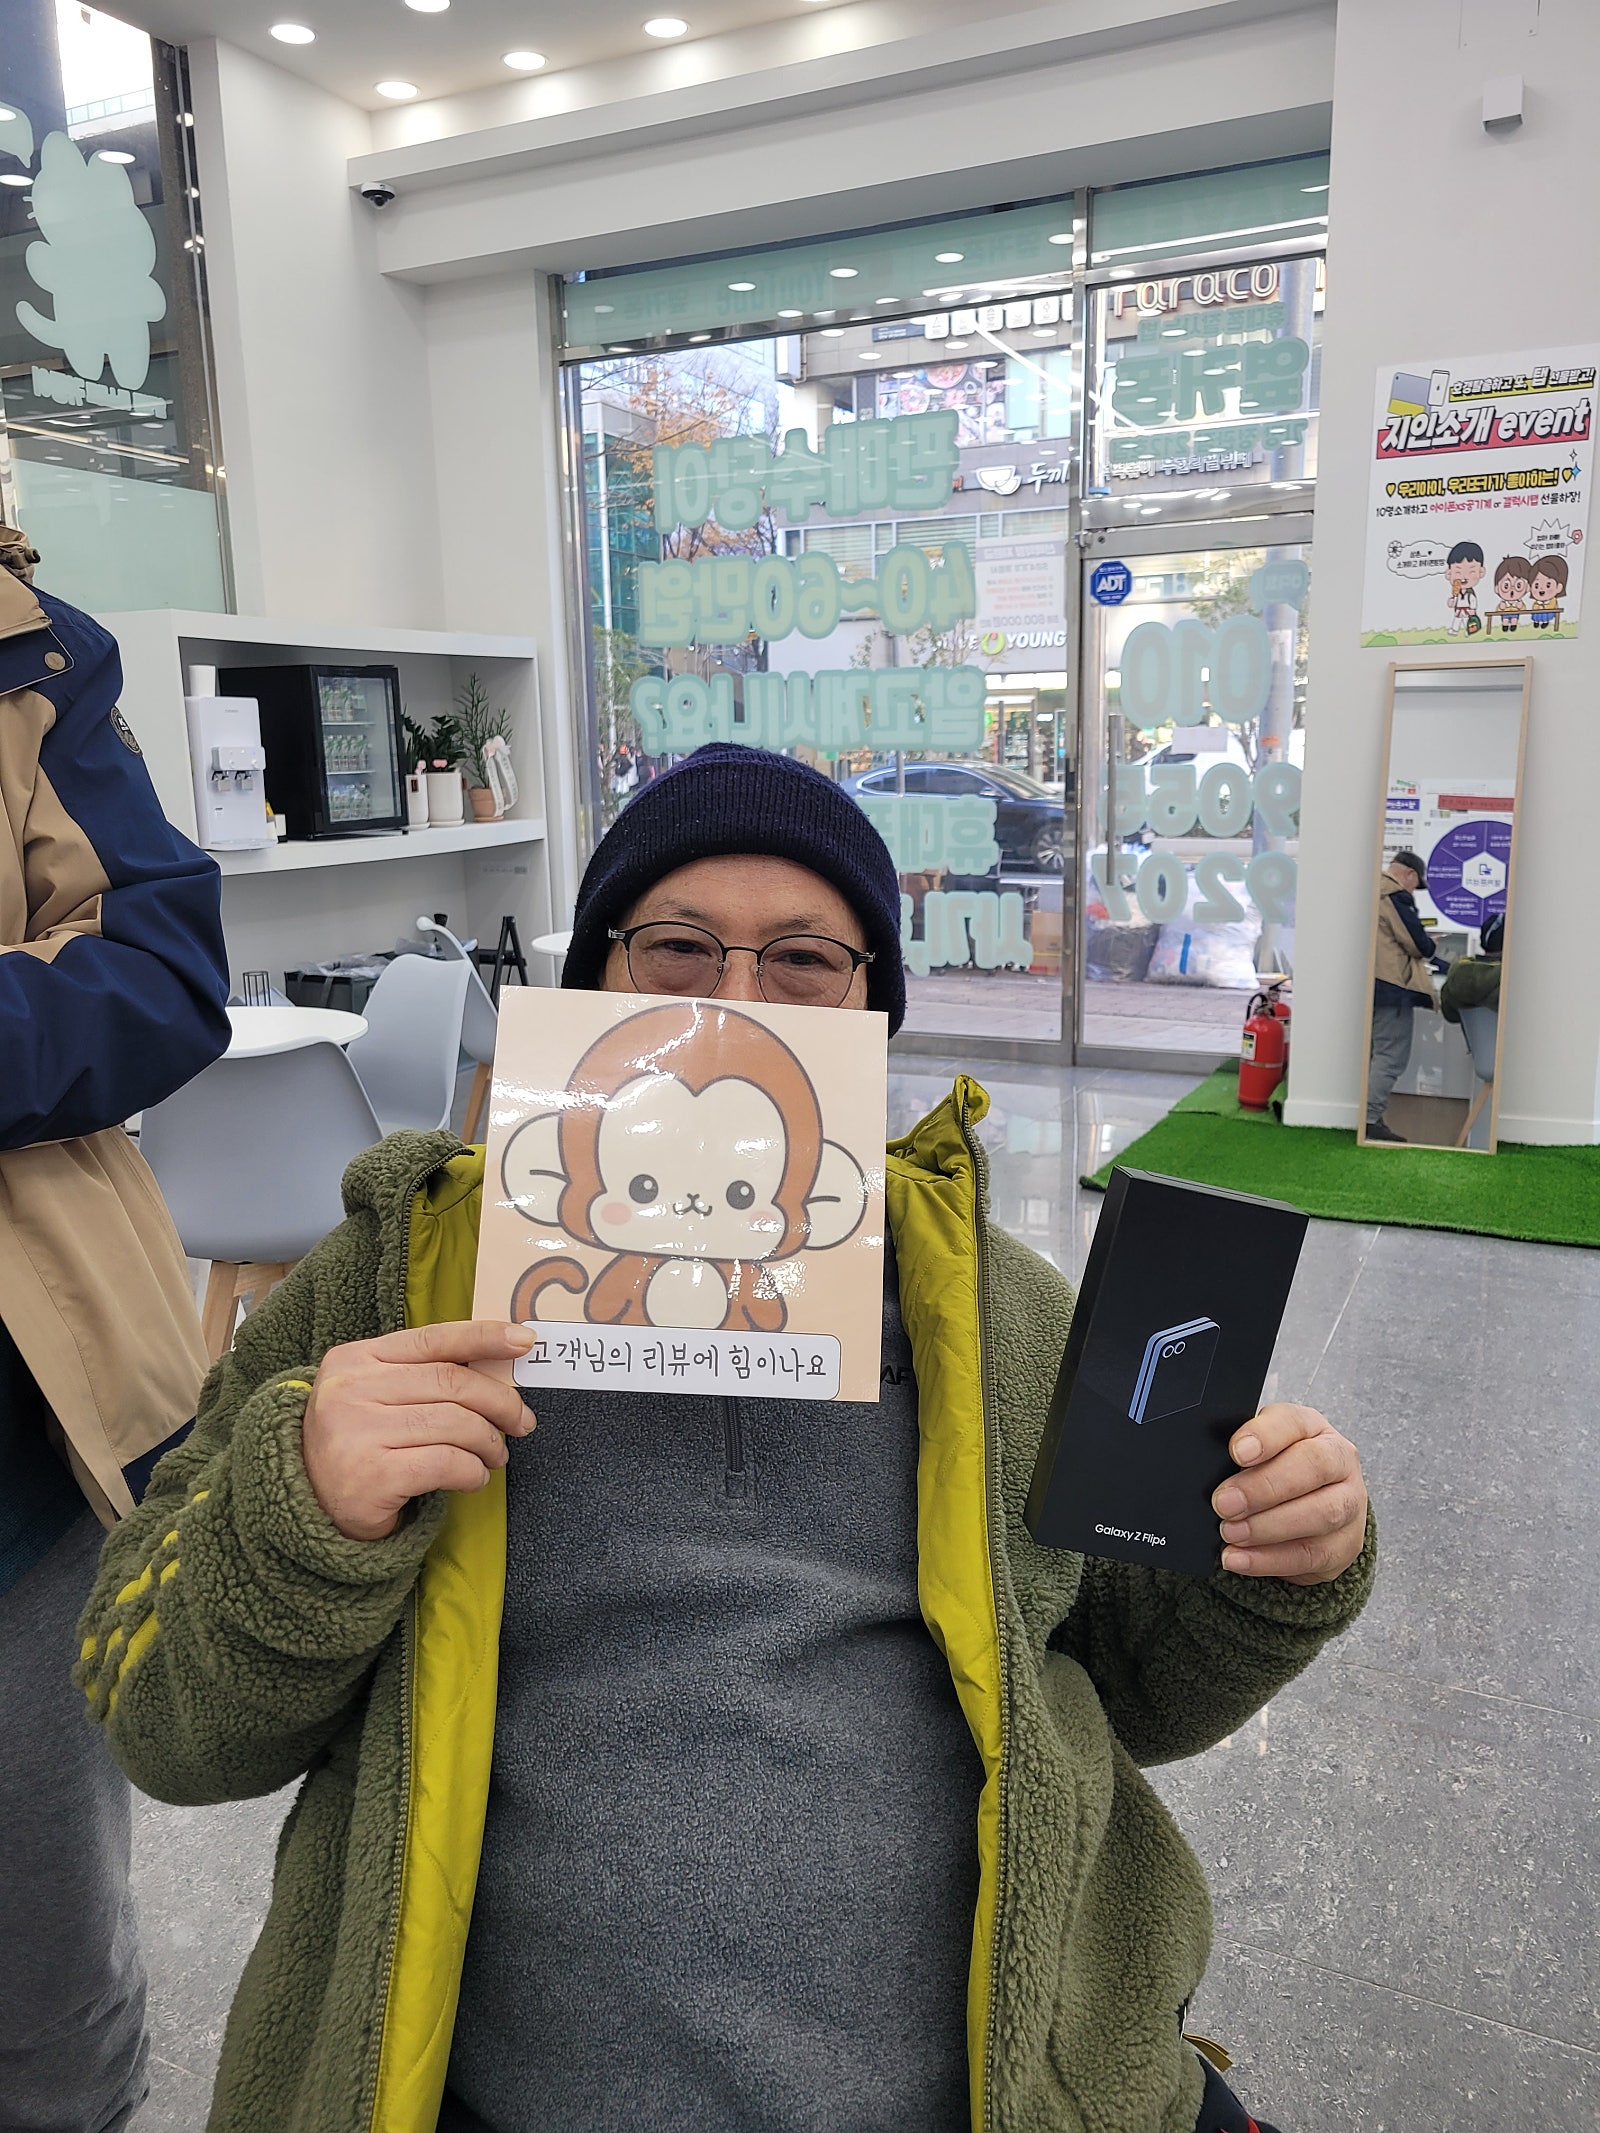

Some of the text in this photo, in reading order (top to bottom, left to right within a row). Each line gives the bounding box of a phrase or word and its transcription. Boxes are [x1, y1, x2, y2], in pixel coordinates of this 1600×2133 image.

[1381, 398, 1590, 451] 지인소개 event
[1096, 574, 1127, 593] ADT
[1006, 630, 1067, 649] YOUNG
[527, 1337, 633, 1374] 고객님의
[642, 1340, 719, 1377] 리뷰에
[1094, 1523, 1167, 1546] Galaxy Z Flip6
